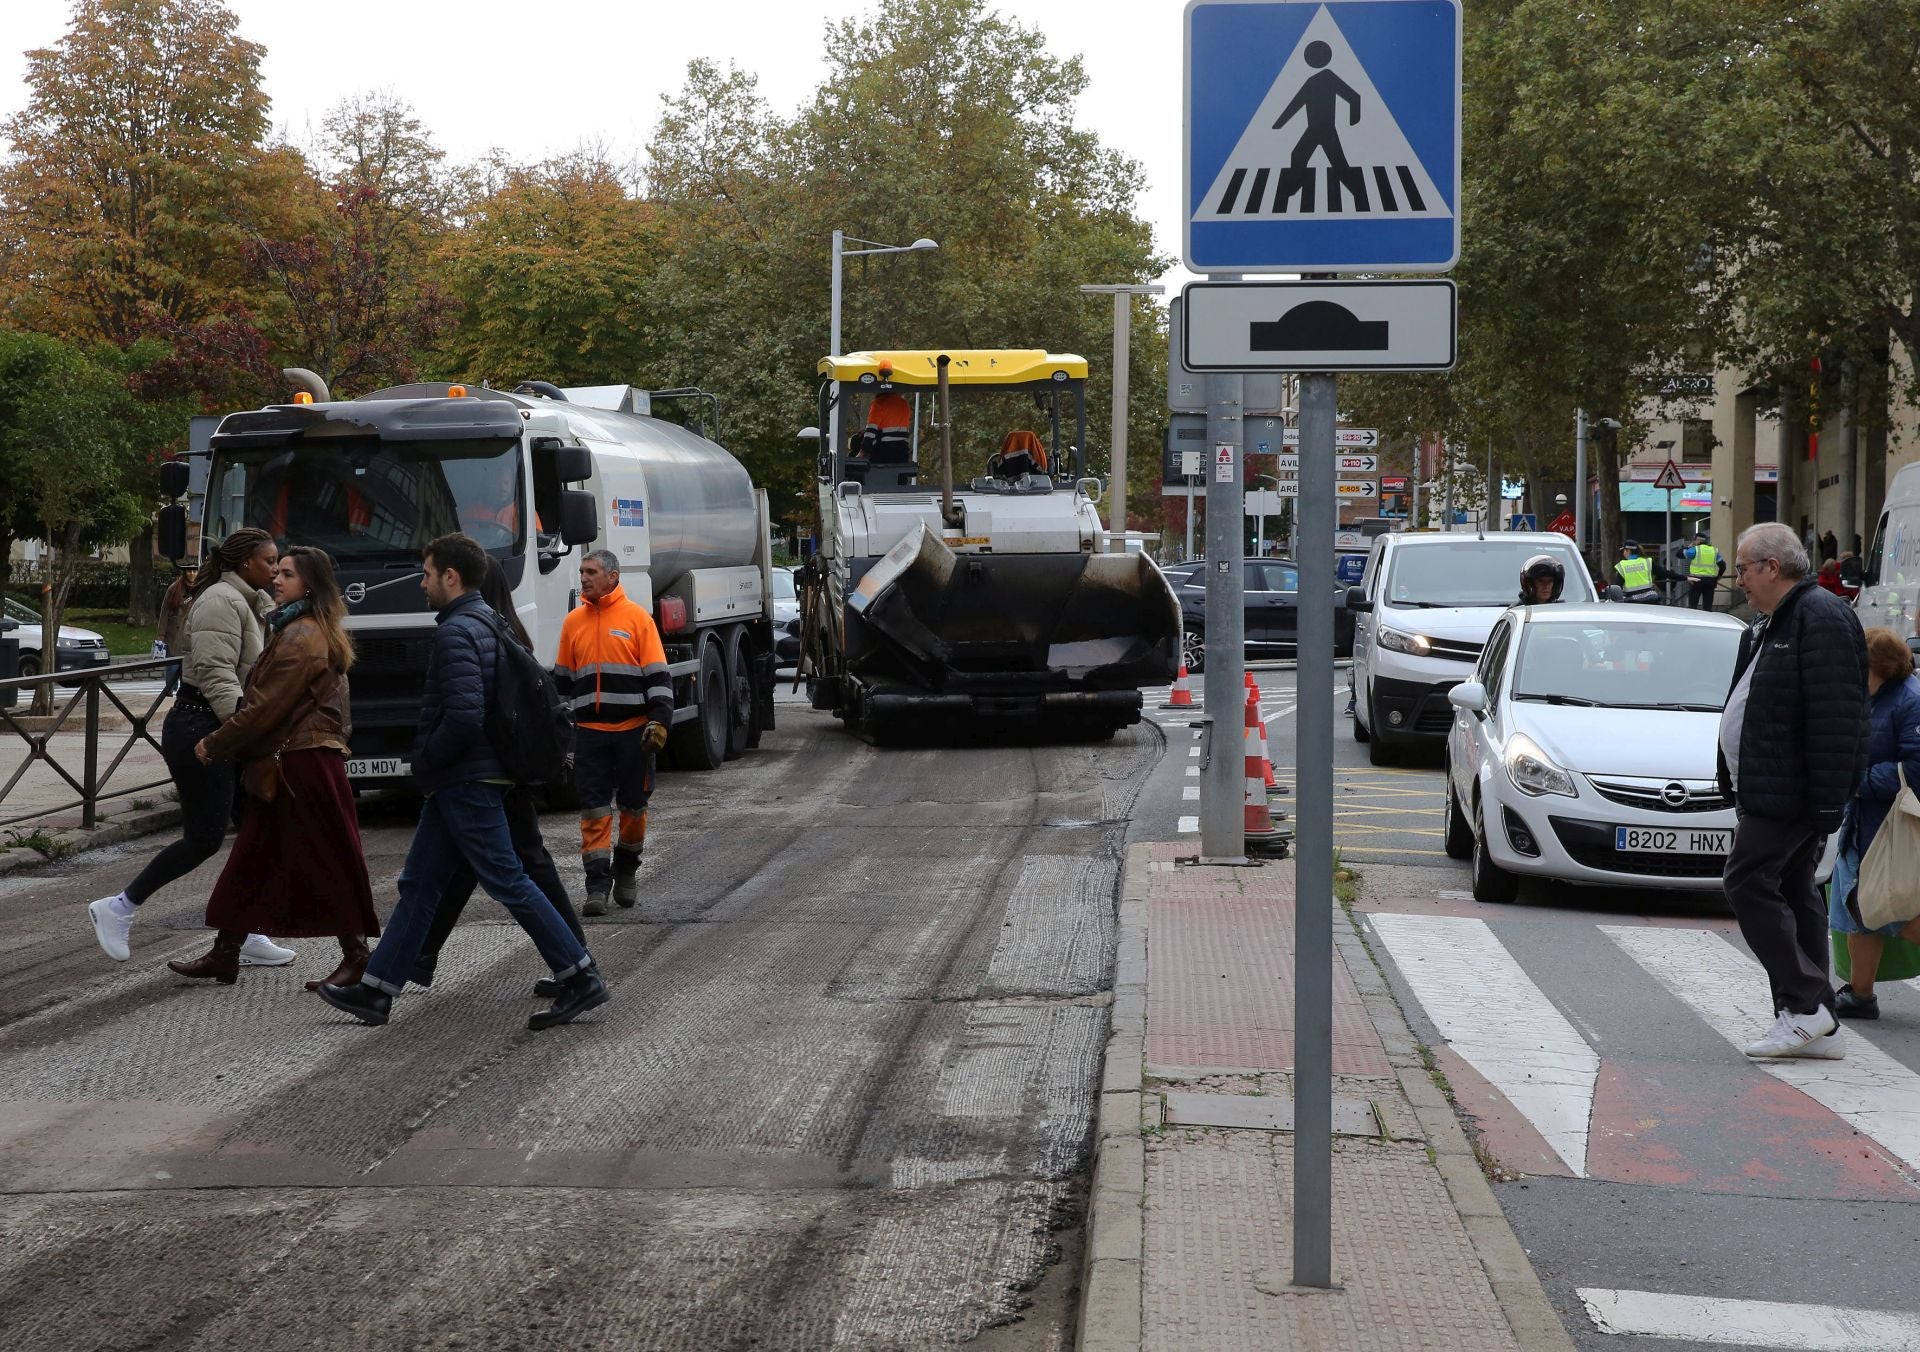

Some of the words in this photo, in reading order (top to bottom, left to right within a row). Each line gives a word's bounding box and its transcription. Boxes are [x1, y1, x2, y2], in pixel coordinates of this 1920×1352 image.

[1280, 459, 1299, 467] ÁVIL
[1342, 459, 1360, 467] N-110
[371, 760, 397, 774] MDV
[1628, 830, 1677, 850] 8202
[1690, 832, 1726, 852] HNX
